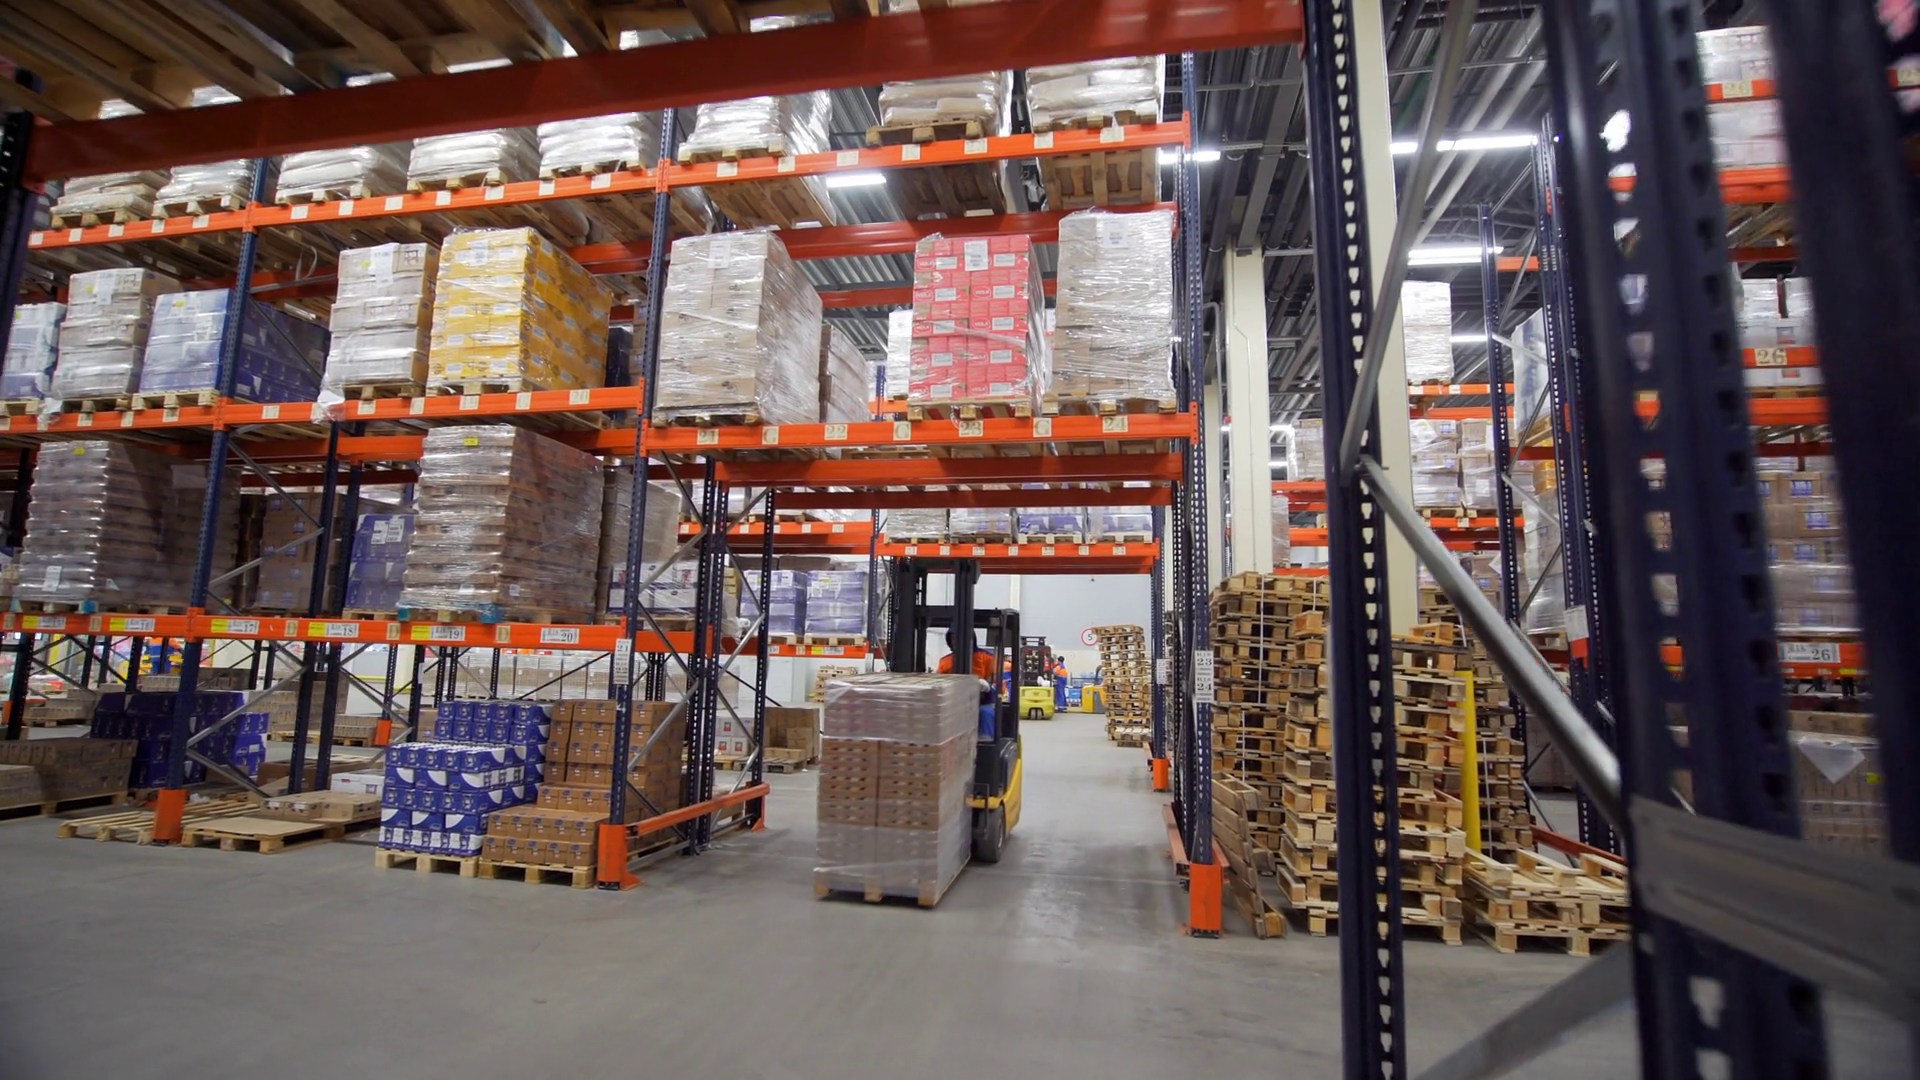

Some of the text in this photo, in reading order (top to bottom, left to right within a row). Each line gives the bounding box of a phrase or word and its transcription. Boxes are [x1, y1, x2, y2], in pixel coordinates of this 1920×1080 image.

[1757, 348, 1785, 364] 26
[959, 421, 982, 435] 23
[1103, 417, 1127, 431] 24
[699, 430, 715, 442] 21
[827, 425, 846, 438] 22
[245, 623, 257, 633] 17
[343, 626, 354, 636] 18
[448, 629, 460, 639] 19
[561, 632, 574, 642] 20
[1087, 633, 1093, 641] 5
[1811, 648, 1831, 661] 26
[1197, 657, 1212, 666] 23
[1197, 682, 1212, 691] 24
